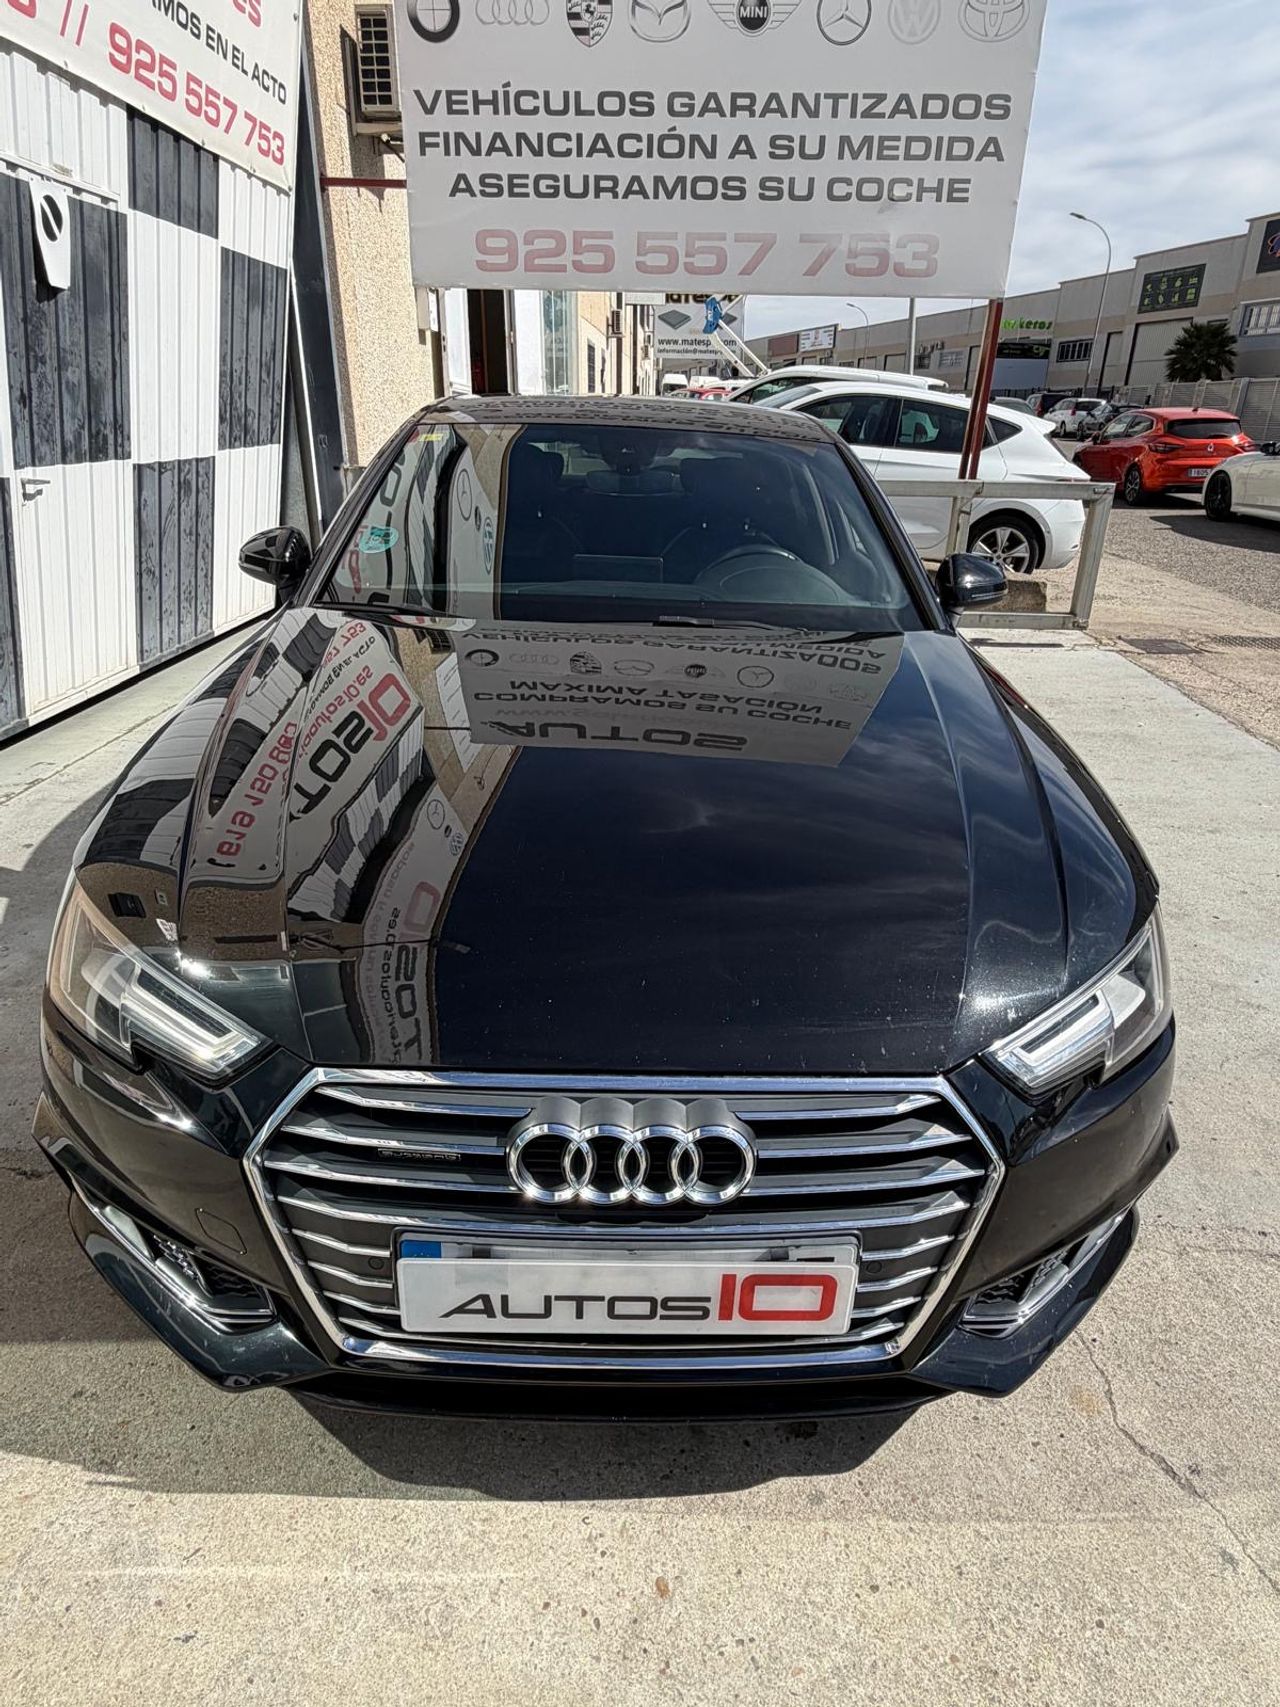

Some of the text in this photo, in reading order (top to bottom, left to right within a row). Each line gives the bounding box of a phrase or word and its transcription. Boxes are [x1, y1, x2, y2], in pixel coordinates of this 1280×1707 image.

[739, 6, 768, 19] MINI
[206, 23, 228, 60] EN
[232, 44, 249, 77] EL
[251, 62, 287, 105] ACTO
[107, 22, 178, 102] 925
[185, 71, 238, 135] 557
[244, 110, 285, 166] 753
[413, 80, 1012, 120] VEHÍCULOS GARANTIZADOS
[418, 125, 1005, 162] FINANCIACIÓN A SU MEDIDA
[449, 173, 971, 203] ASEGURAMOS SU COCHE
[475, 229, 940, 278] 925 557 753
[439, 1273, 838, 1322] AUTOS10
